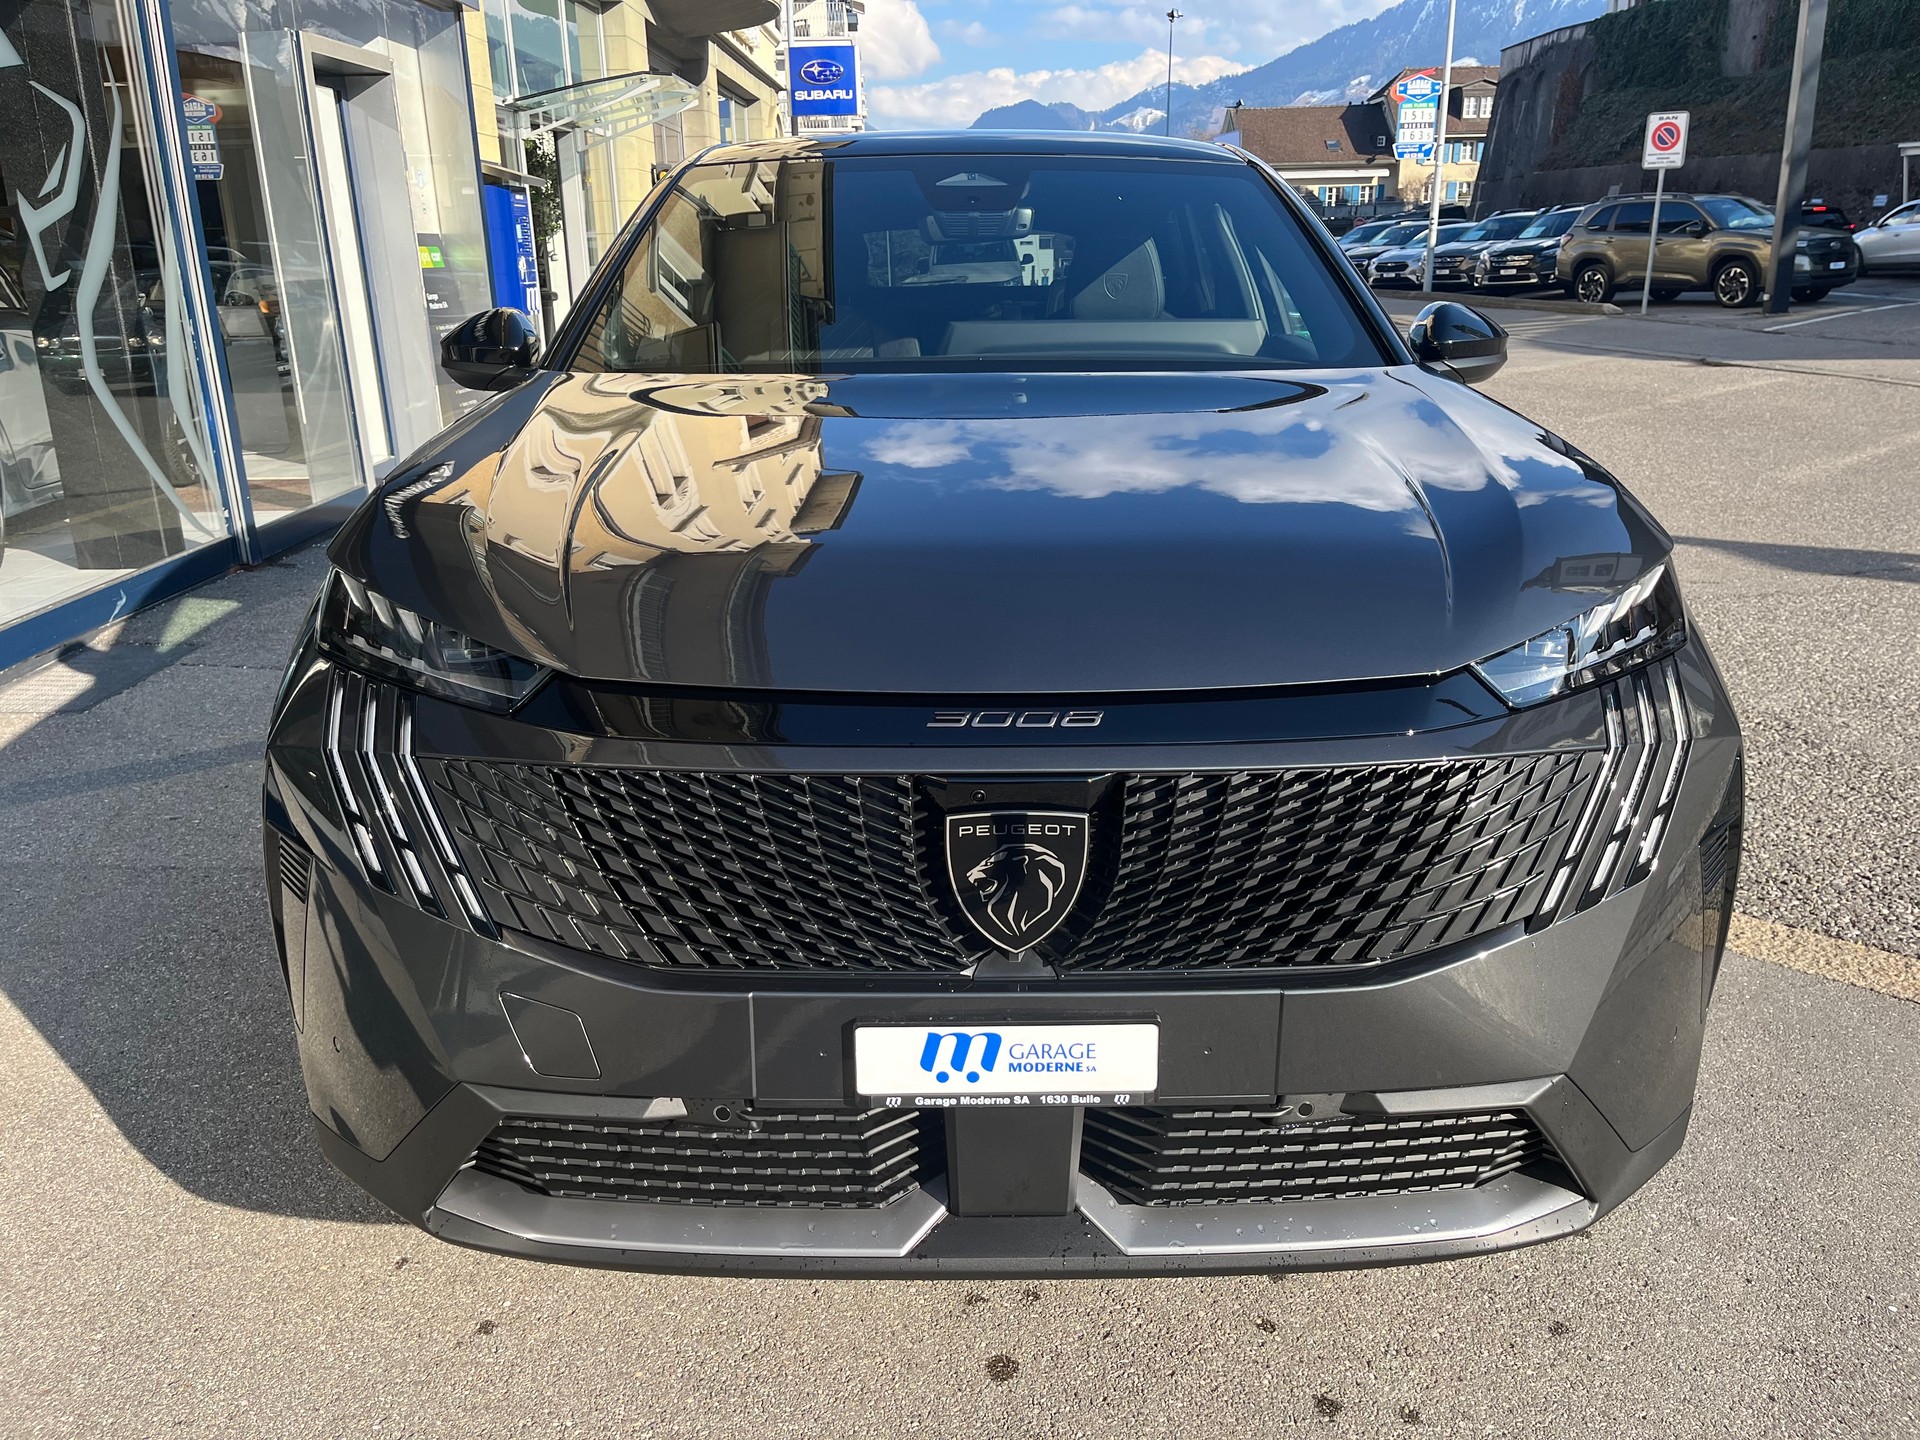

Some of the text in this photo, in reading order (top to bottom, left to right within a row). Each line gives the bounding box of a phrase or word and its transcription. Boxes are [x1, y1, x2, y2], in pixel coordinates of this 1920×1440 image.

[794, 90, 853, 101] SUBARU
[926, 710, 1105, 728] 3008
[958, 823, 1077, 838] PEUGEOT
[1008, 1043, 1097, 1060] GARAGE
[1008, 1061, 1097, 1073] MODERNE SA
[914, 1096, 957, 1107] Garage
[960, 1095, 1012, 1105] Moderne
[1013, 1095, 1030, 1105] SA
[1040, 1094, 1068, 1104] 1630
[1071, 1094, 1101, 1104] Bulle
